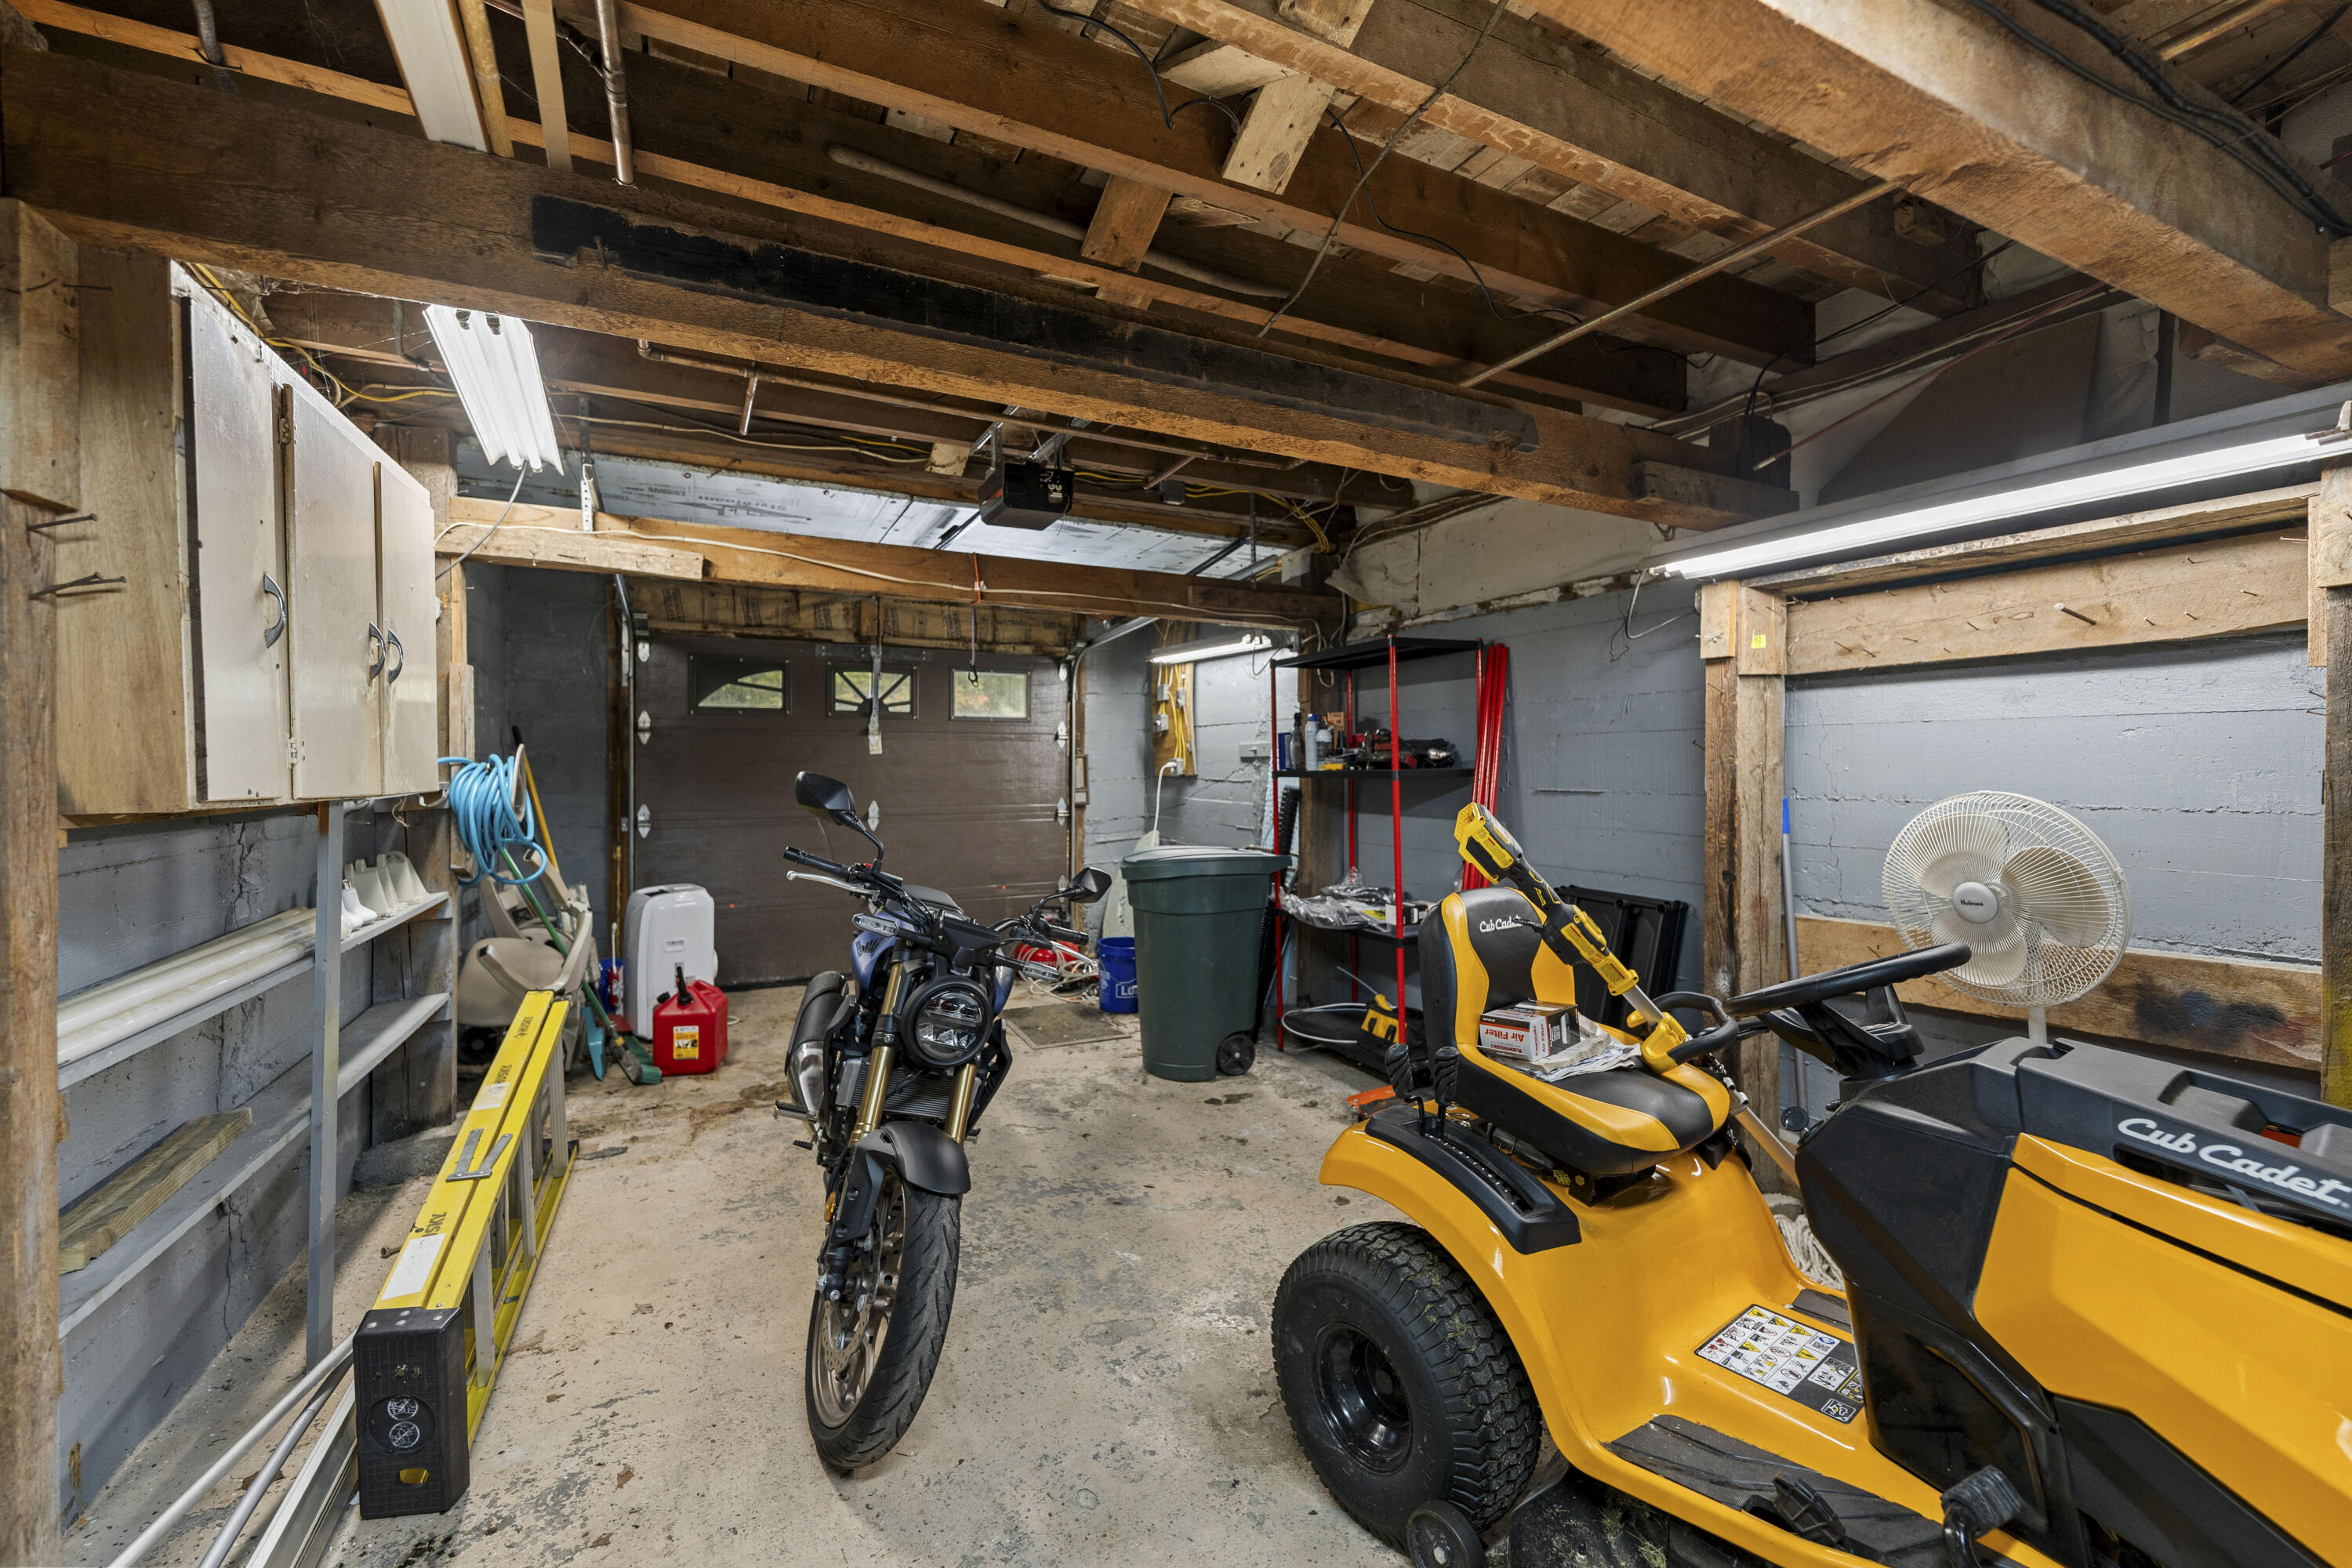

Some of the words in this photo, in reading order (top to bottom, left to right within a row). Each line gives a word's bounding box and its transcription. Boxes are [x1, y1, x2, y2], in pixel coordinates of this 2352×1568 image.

[1479, 919, 1495, 933] Cub
[855, 940, 863, 959] HONDA
[517, 1016, 533, 1033] HUSKY
[1484, 1028, 1508, 1040] Filter
[1510, 1033, 1525, 1043] Air
[1490, 1044, 1522, 1054] Kawasaki
[2118, 1117, 2197, 1153] Cub
[2198, 1144, 2352, 1206] Cadet
[422, 1212, 447, 1237] SKY
